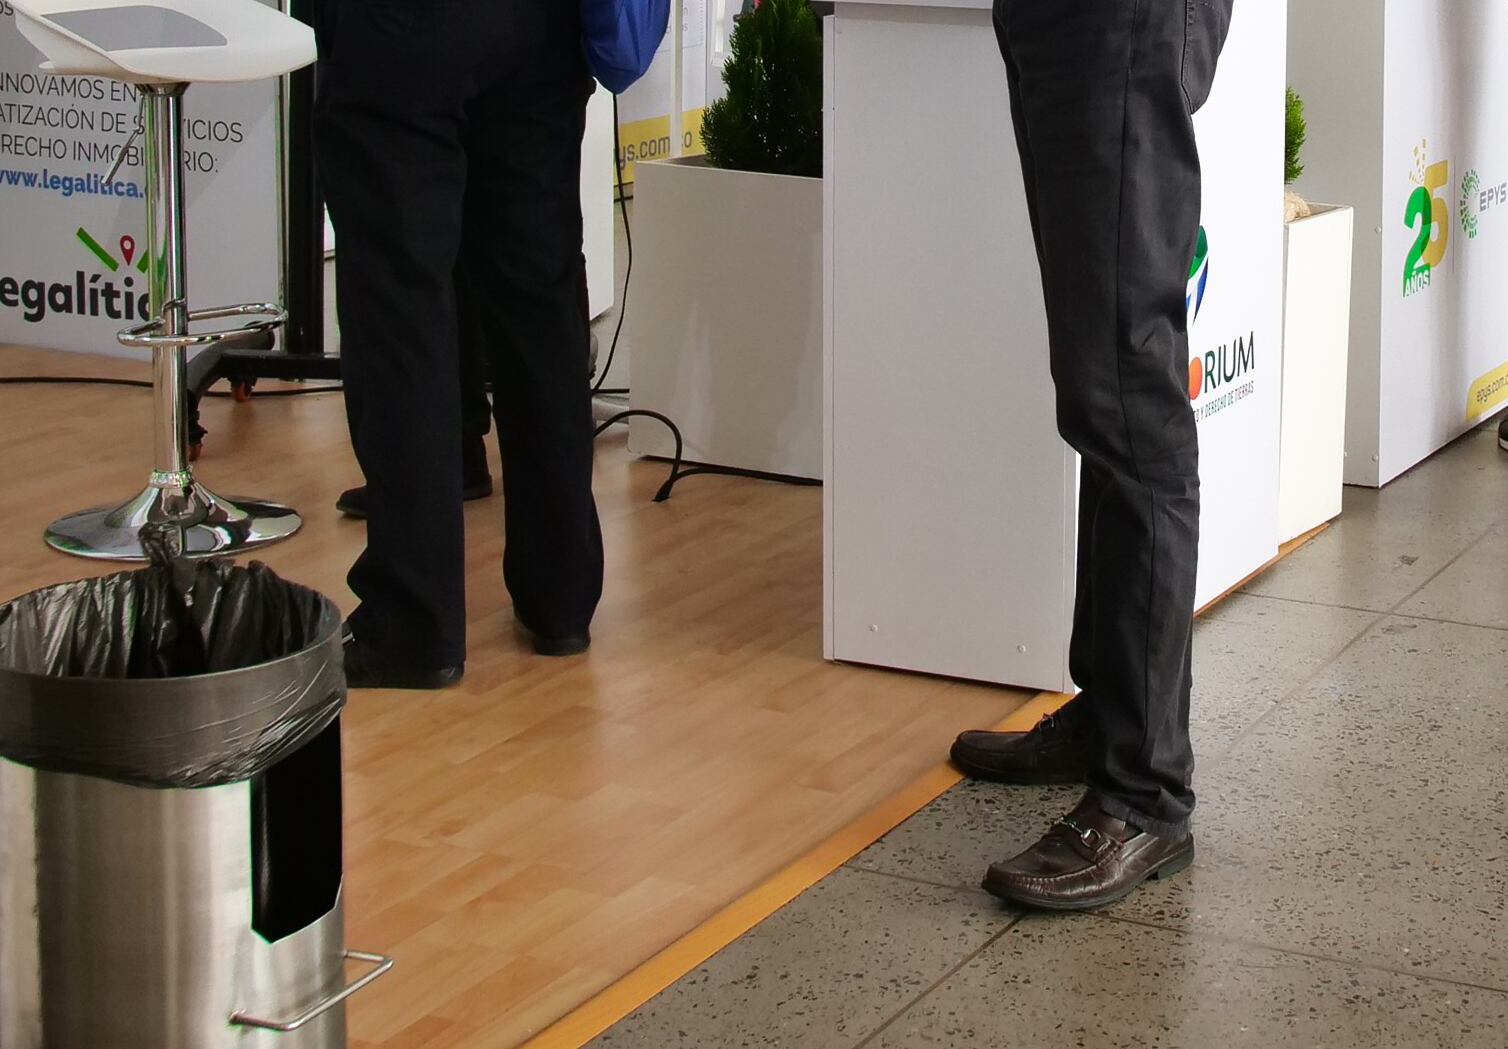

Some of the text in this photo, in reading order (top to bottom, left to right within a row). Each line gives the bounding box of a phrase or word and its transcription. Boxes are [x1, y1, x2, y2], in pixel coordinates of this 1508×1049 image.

[0, 73, 137, 102] NOVAMOS EN
[101, 112, 126, 133] DE
[0, 134, 67, 159] RECHO
[1479, 182, 1507, 213] EPYS
[0, 270, 150, 323] egalíti
[1189, 331, 1255, 400] ORIUM
